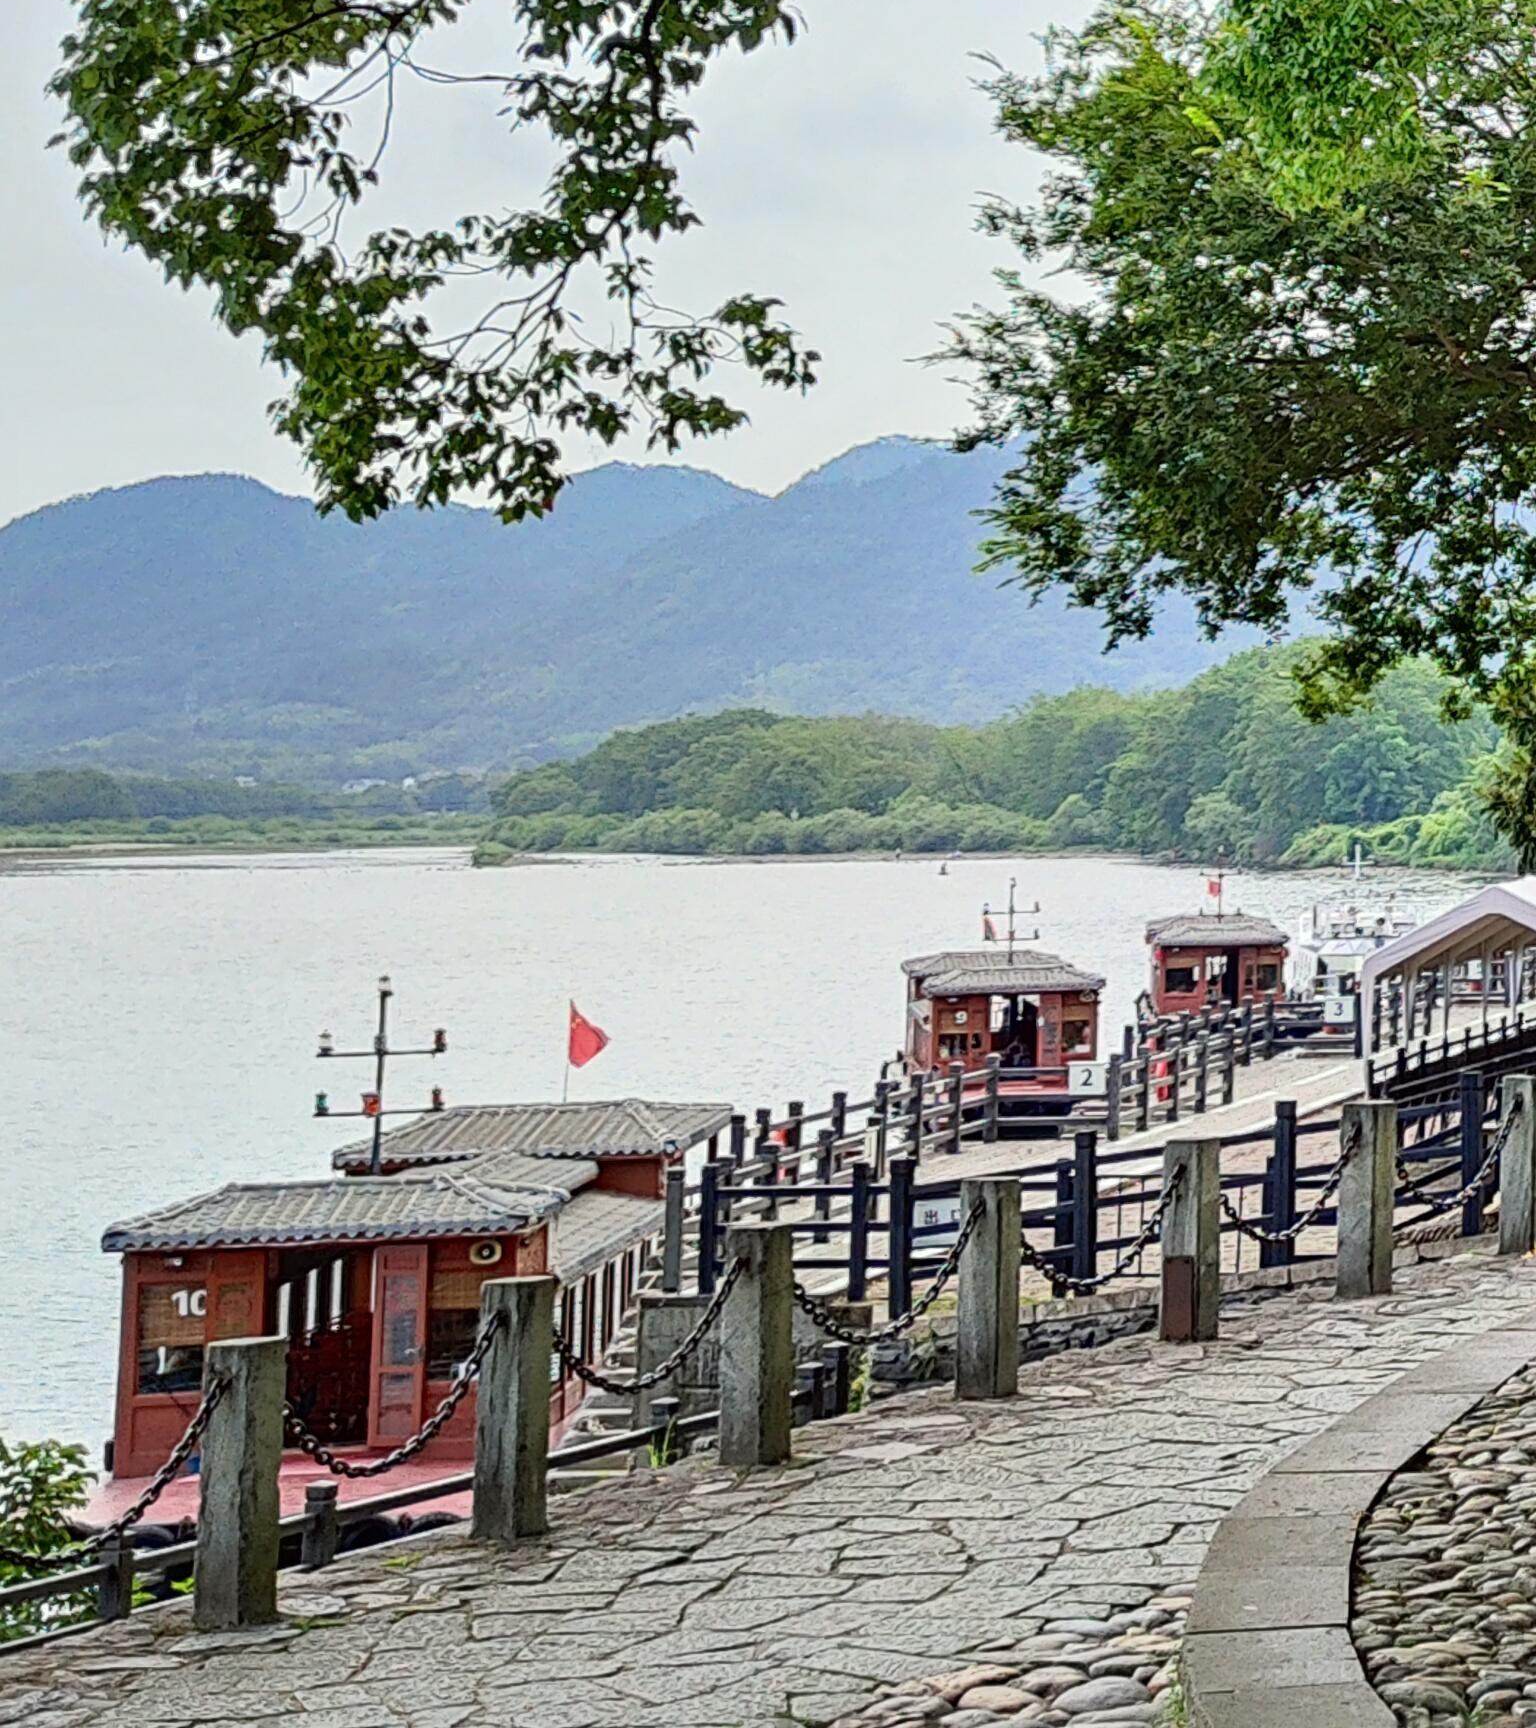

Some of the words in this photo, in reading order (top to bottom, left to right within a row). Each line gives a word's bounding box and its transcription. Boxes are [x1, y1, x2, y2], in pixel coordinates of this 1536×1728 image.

[1333, 1002, 1345, 1016] 3
[954, 1010, 968, 1024] 9
[1080, 1068, 1093, 1086] 2
